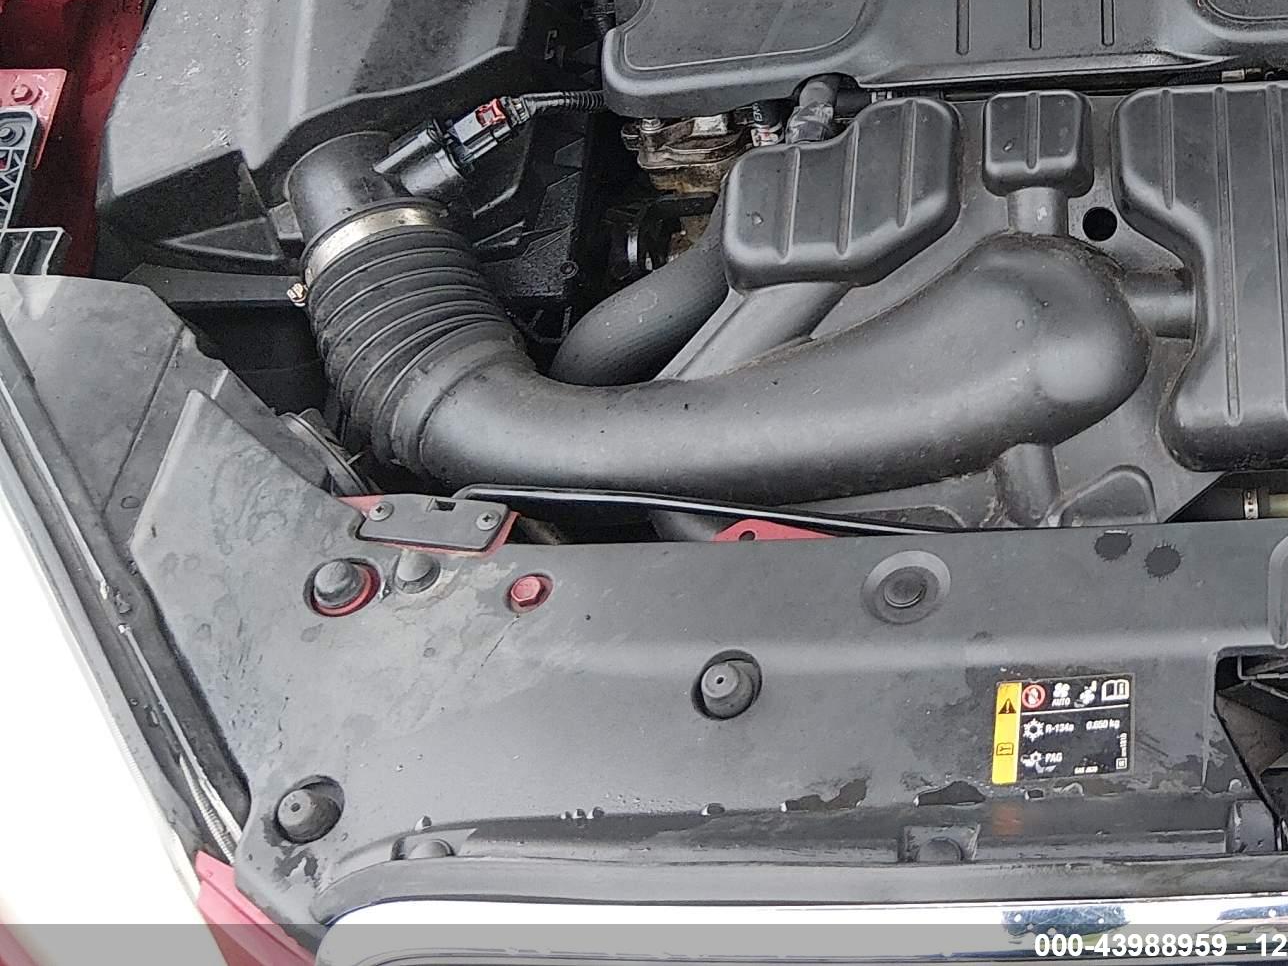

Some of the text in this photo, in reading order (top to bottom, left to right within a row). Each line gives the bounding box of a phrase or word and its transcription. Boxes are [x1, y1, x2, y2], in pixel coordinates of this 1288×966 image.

[1052, 697, 1071, 707] AUTO
[1045, 722, 1075, 735] R-134a
[1045, 752, 1063, 763] PAG
